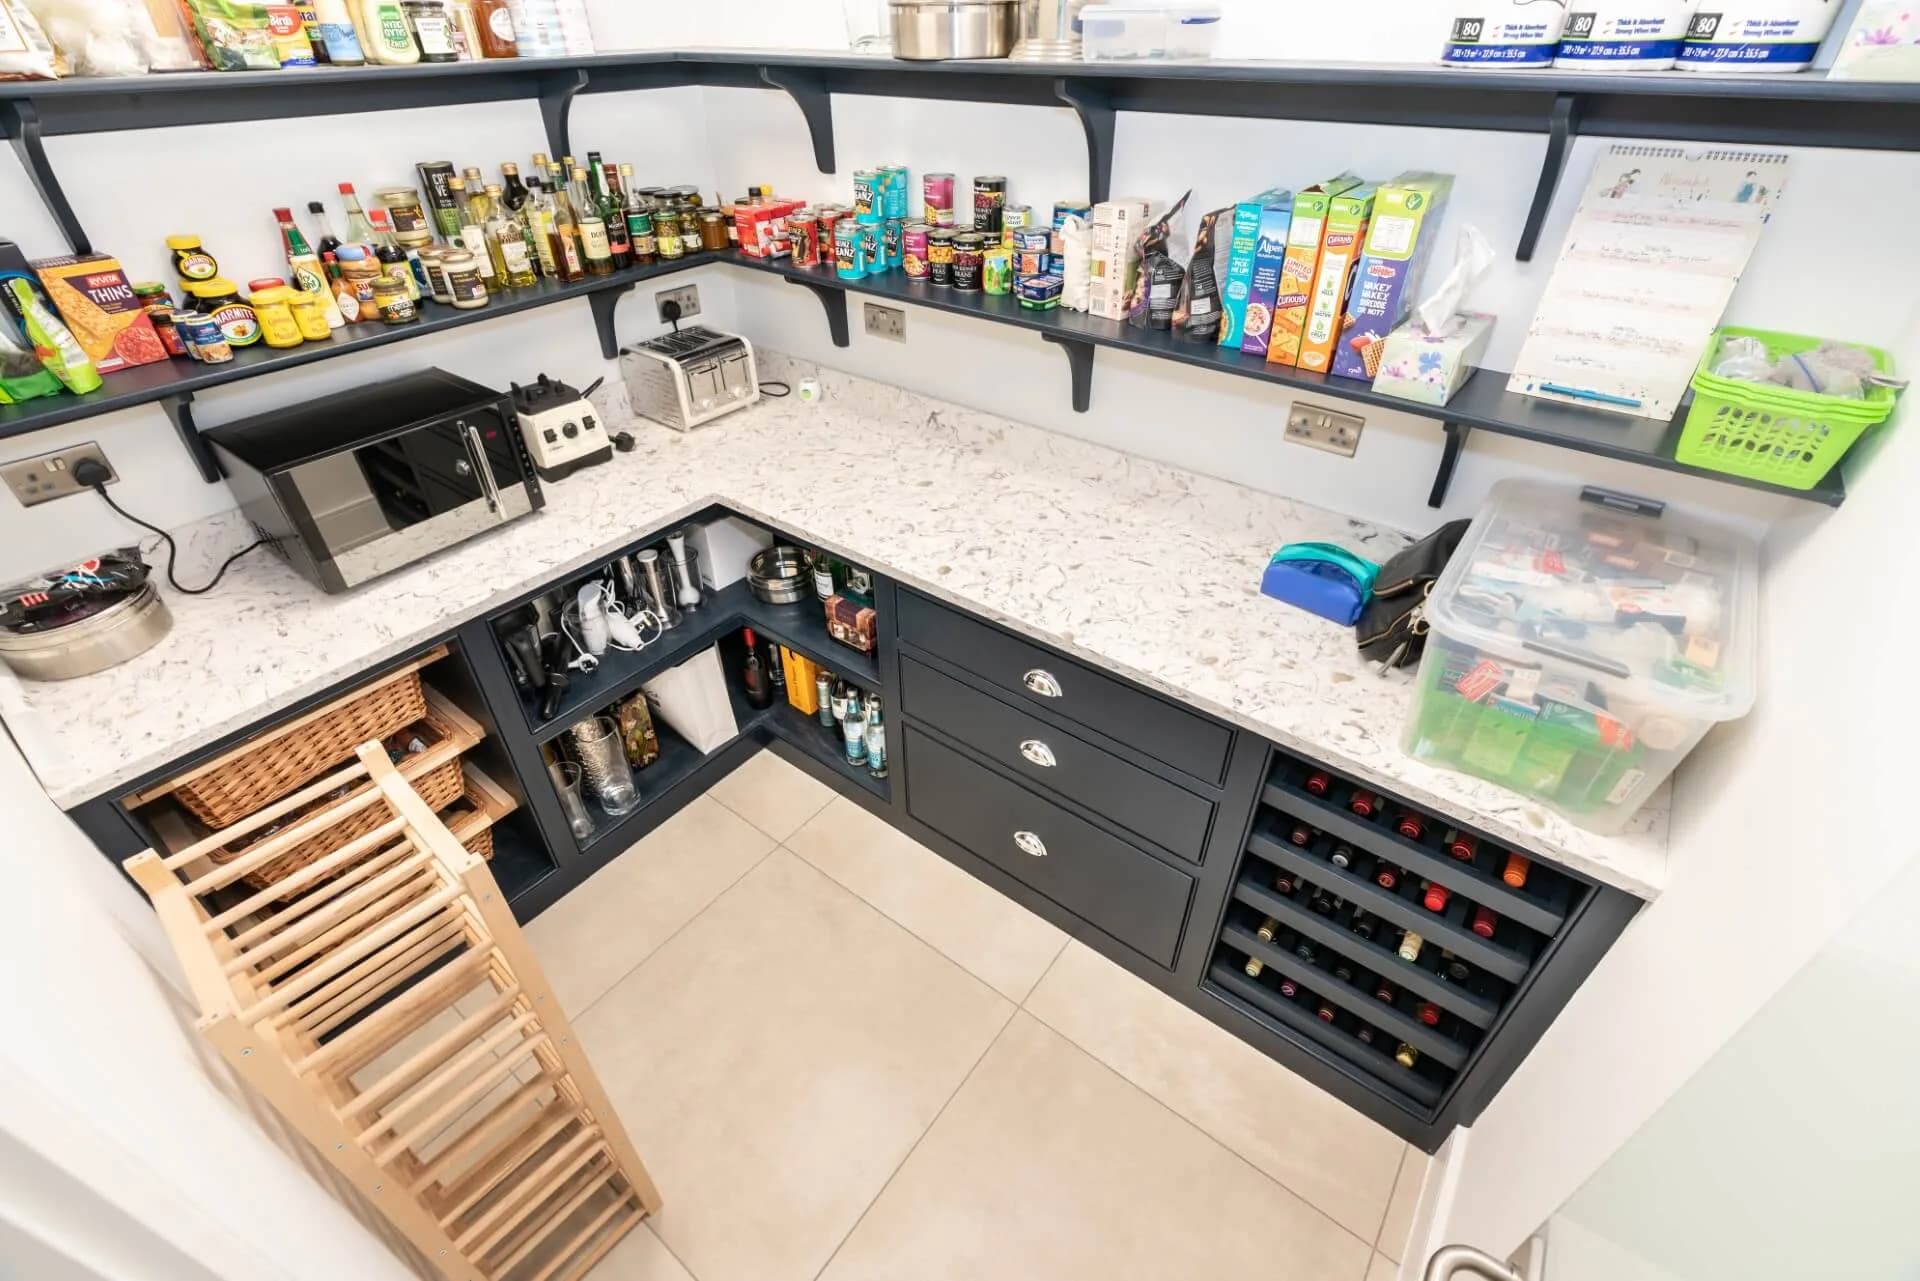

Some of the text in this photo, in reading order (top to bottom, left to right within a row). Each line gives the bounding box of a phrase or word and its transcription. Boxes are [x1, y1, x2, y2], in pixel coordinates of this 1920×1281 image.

[1463, 22, 1481, 36] 80
[1574, 17, 1592, 32] 80
[1697, 18, 1717, 33] 80
[1259, 240, 1283, 254] Alpen
[1284, 264, 1309, 281] EDITION
[1287, 259, 1312, 274] LIMITED
[88, 285, 133, 304] THINS
[215, 308, 257, 325] MARMITE
